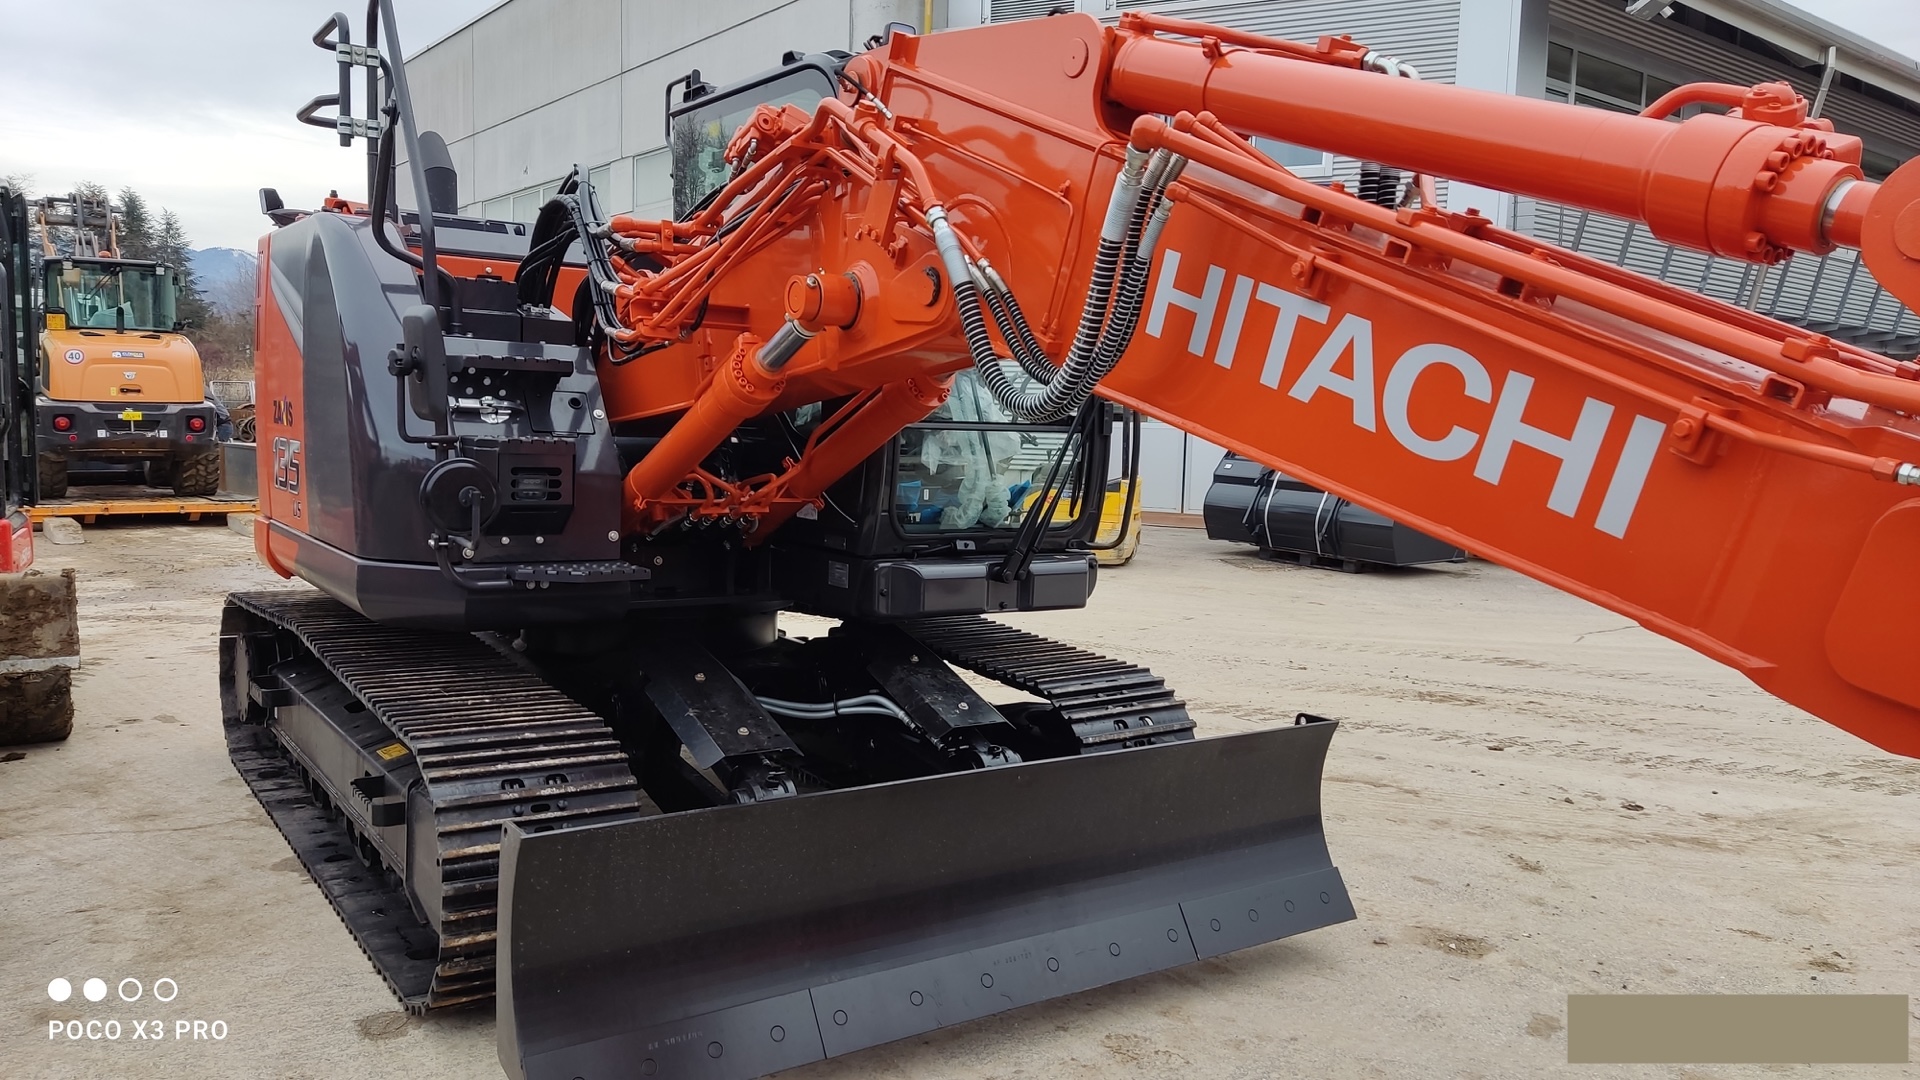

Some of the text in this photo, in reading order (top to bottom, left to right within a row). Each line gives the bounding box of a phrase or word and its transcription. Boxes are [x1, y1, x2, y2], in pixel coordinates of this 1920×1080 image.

[68, 352, 81, 360] 40
[1146, 249, 1666, 539] HITACHI
[273, 437, 301, 494] 135
[293, 499, 302, 520] US
